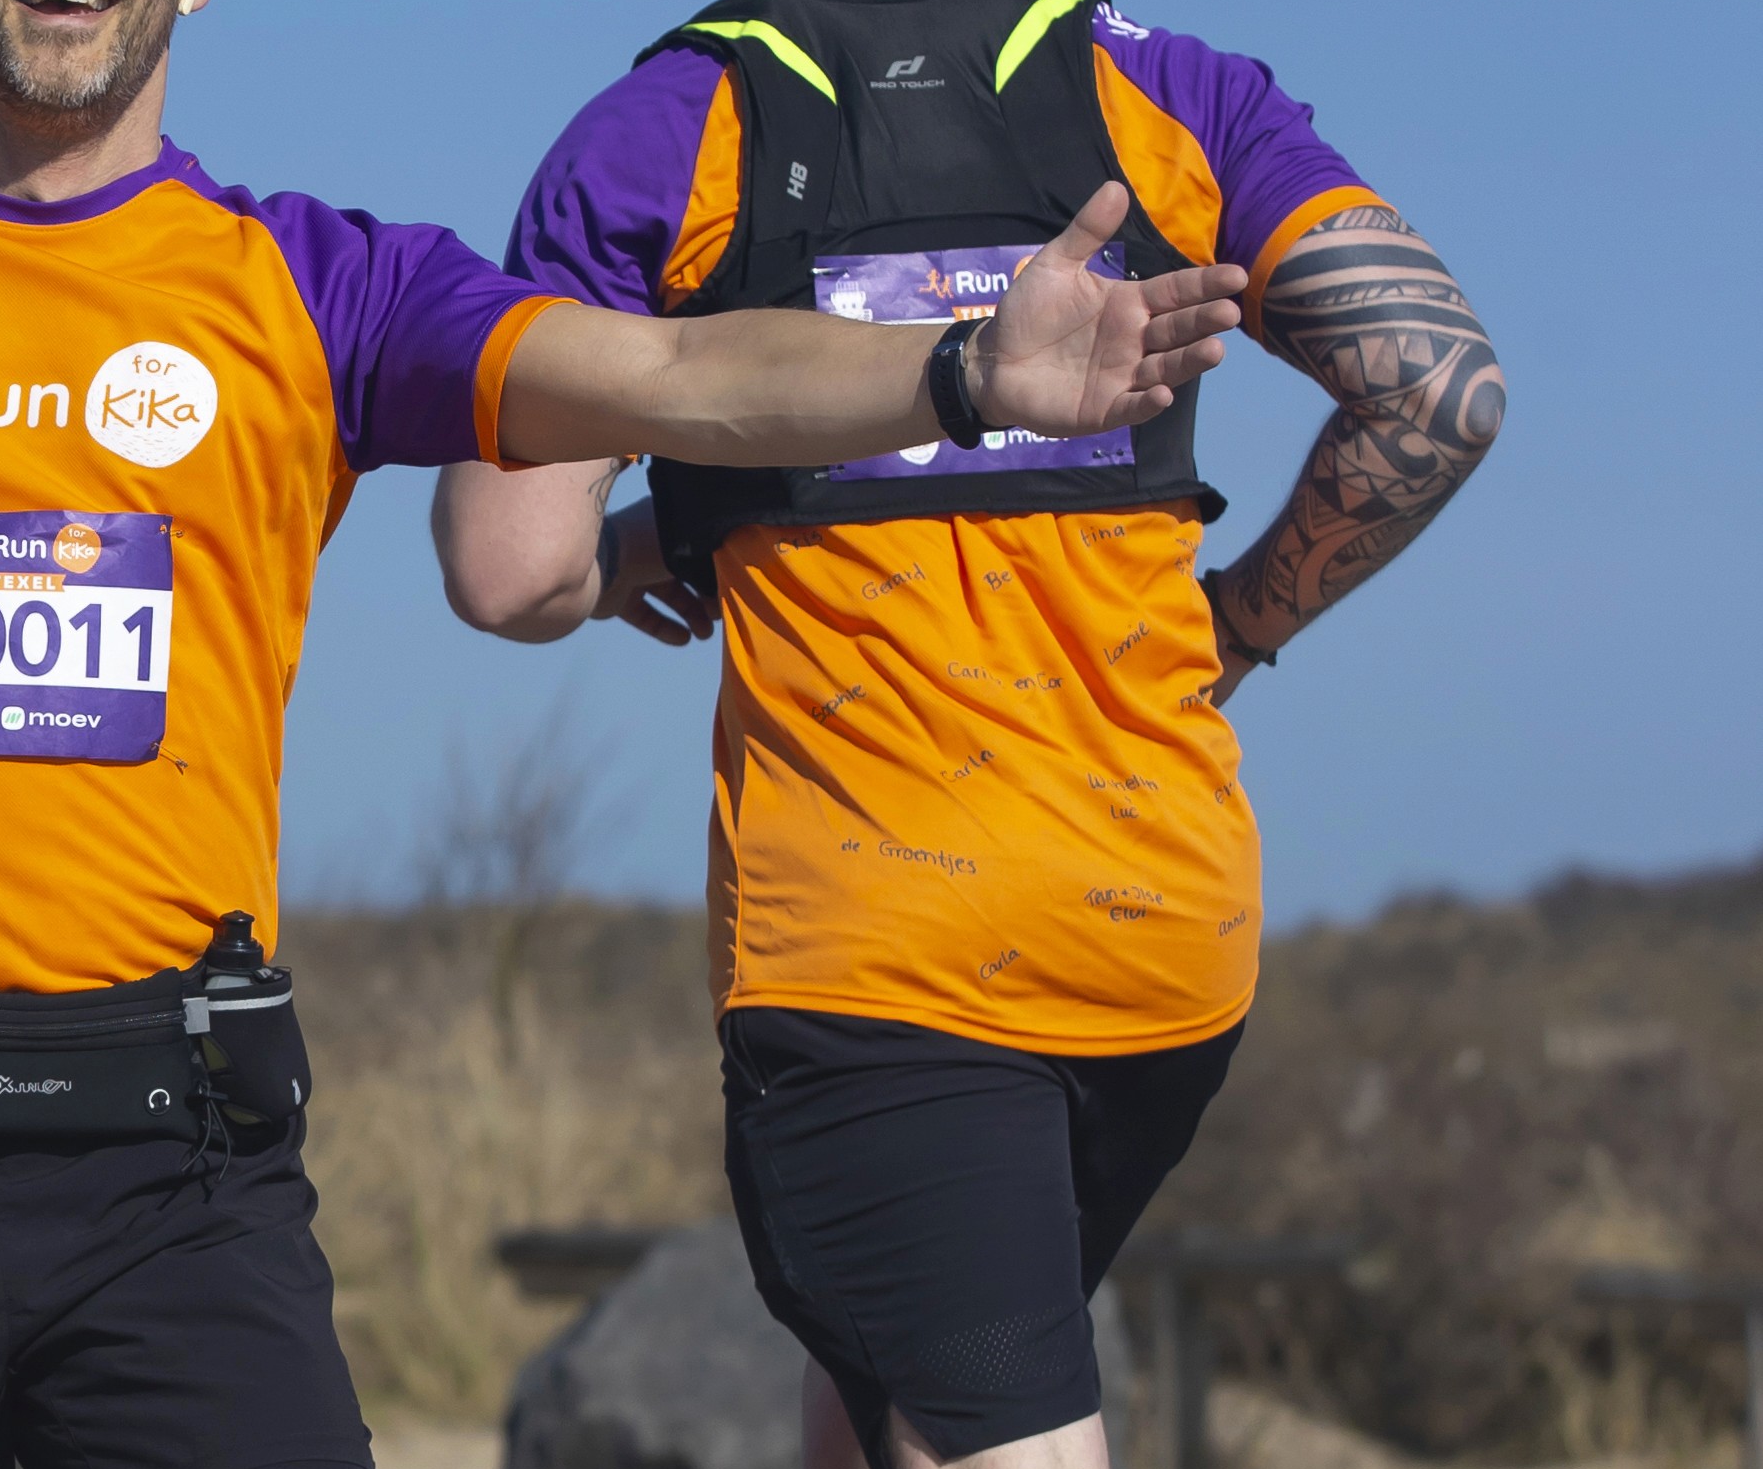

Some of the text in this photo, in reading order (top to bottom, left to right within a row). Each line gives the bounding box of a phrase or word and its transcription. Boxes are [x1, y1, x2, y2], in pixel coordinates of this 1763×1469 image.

[870, 79, 945, 89] PRO TOUCH
[956, 271, 1008, 294] Run
[960, 307, 996, 321] TEX
[132, 353, 177, 376] for
[101, 383, 200, 429] KiKa
[68, 528, 86, 538] for
[58, 540, 95, 560] KiKa
[29, 712, 102, 728] moev
[979, 949, 1022, 980] Carla
